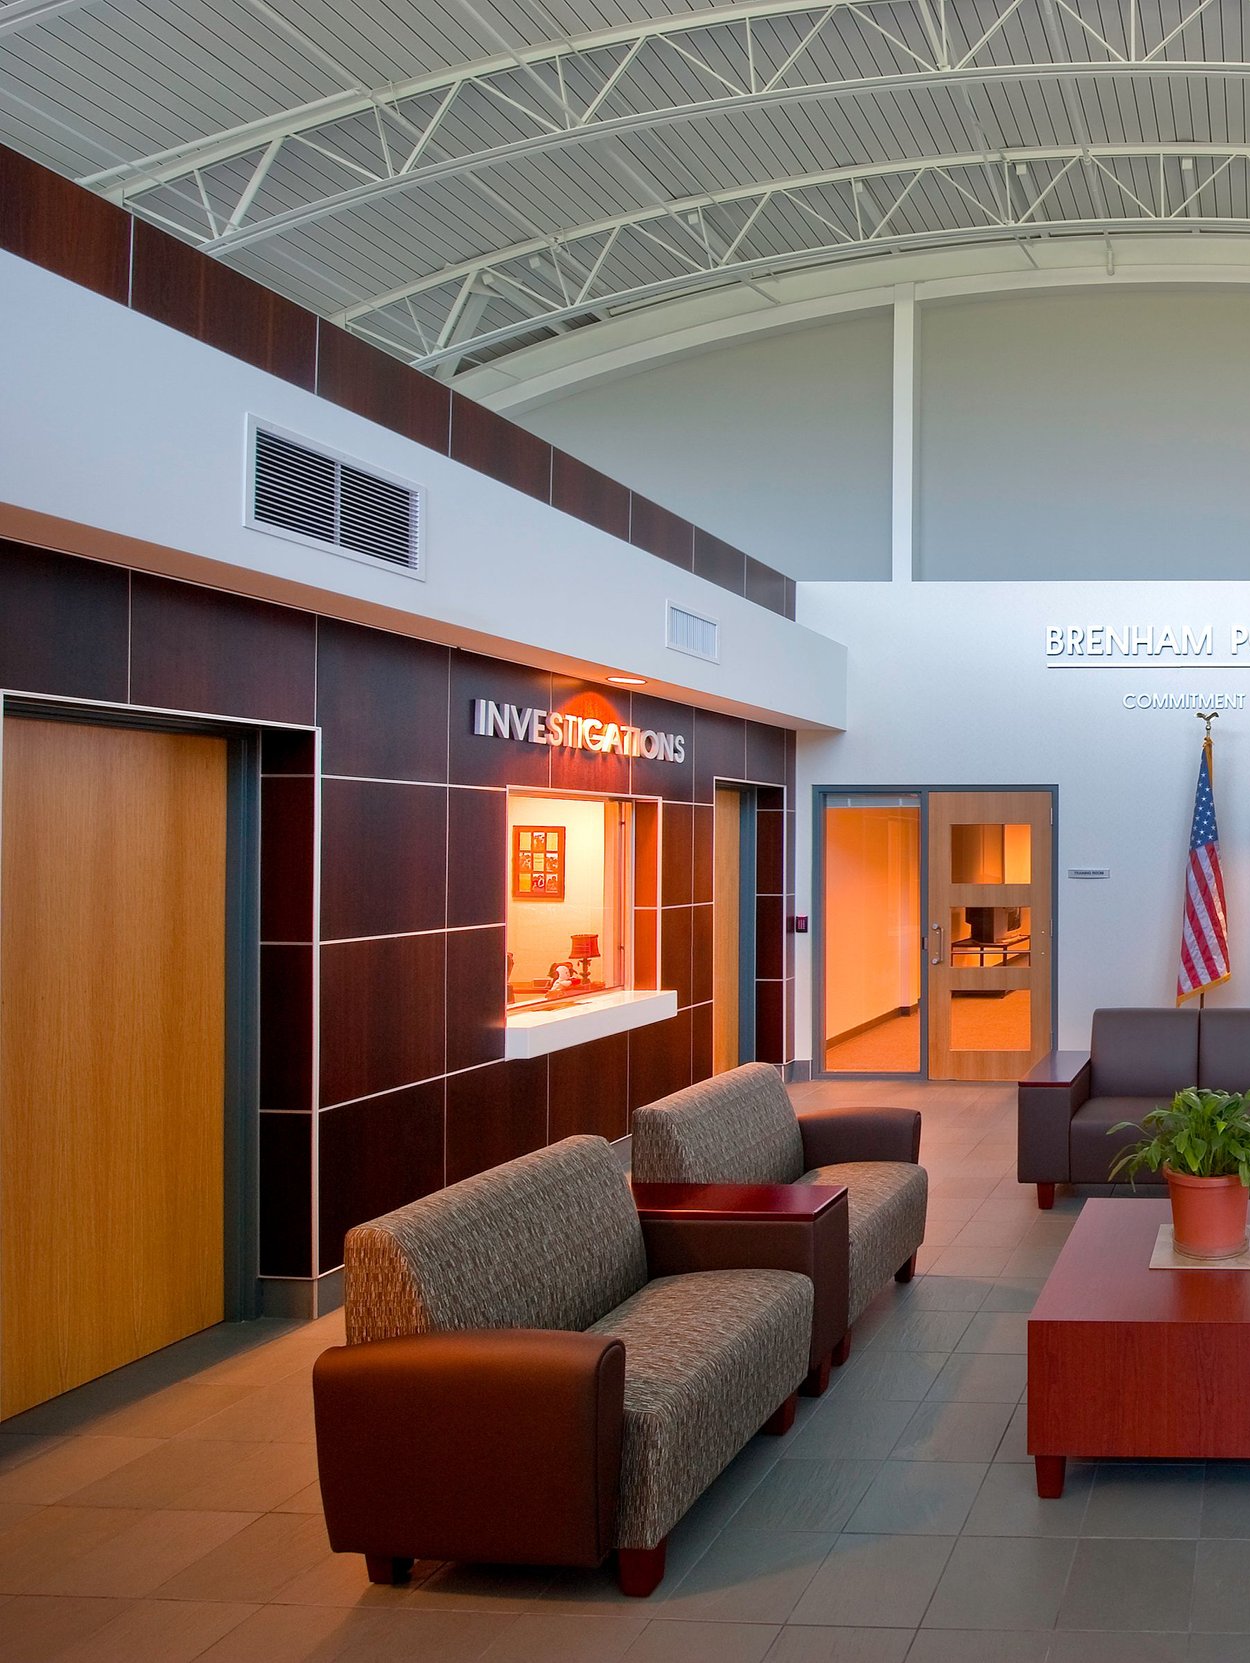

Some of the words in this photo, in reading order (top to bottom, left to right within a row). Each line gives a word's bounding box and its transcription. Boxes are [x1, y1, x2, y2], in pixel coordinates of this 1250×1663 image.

[1045, 624, 1213, 656] BRENHAM
[1122, 692, 1246, 710] COMMITMENT
[474, 699, 685, 763] INVESTIGATIONS
